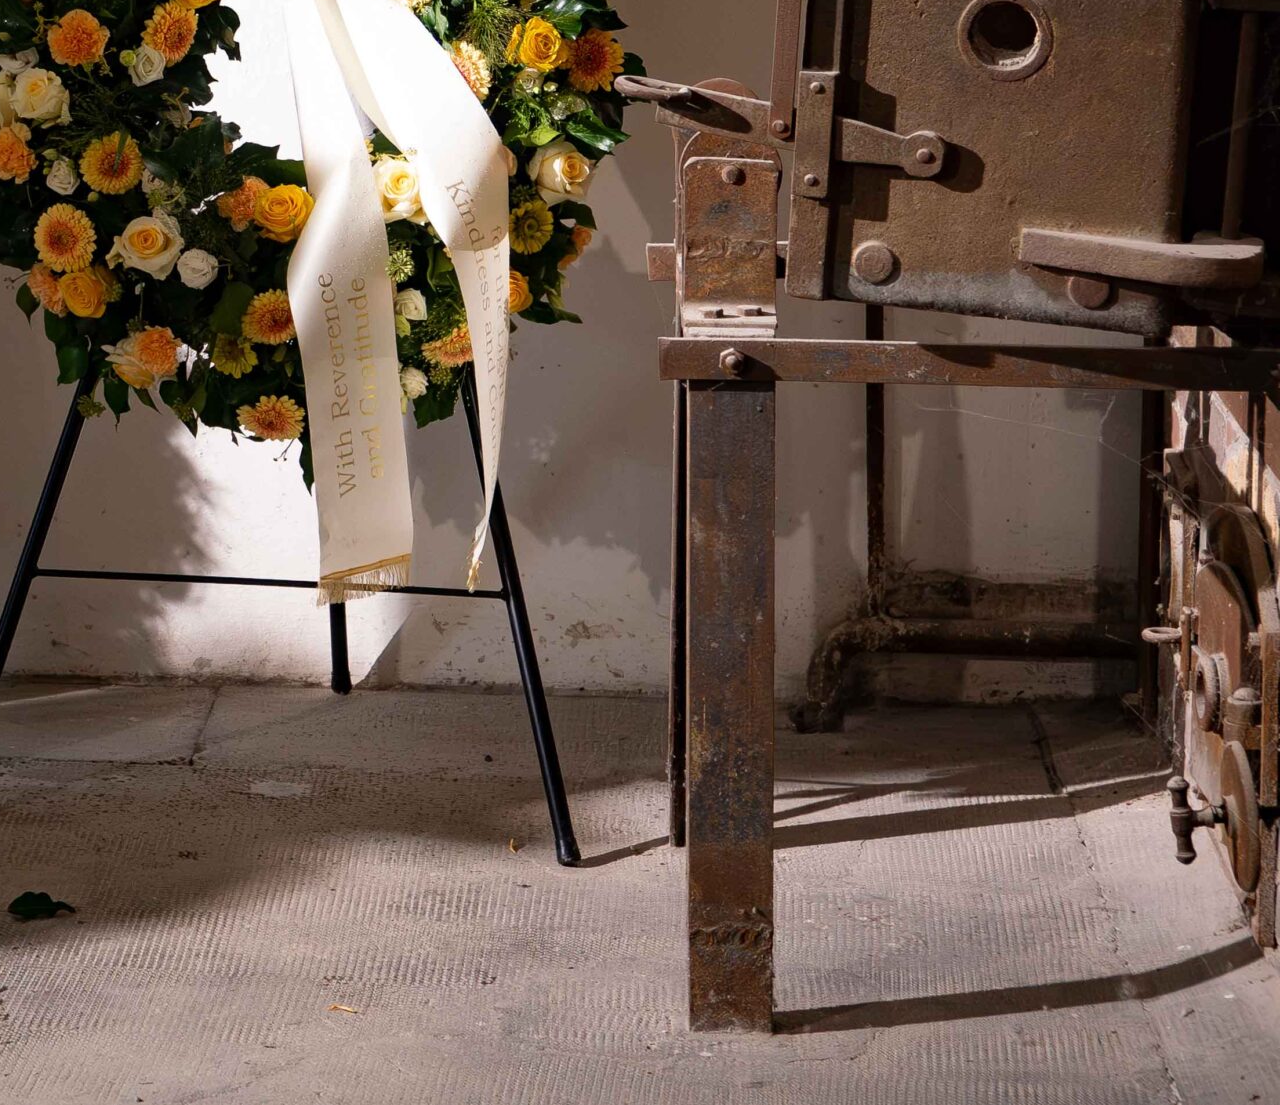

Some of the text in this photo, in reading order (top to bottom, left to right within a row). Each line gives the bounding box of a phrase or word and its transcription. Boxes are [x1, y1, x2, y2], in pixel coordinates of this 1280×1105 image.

[445, 179, 491, 312] Kindness
[318, 272, 356, 499] With Reverence
[361, 426, 384, 479] and
